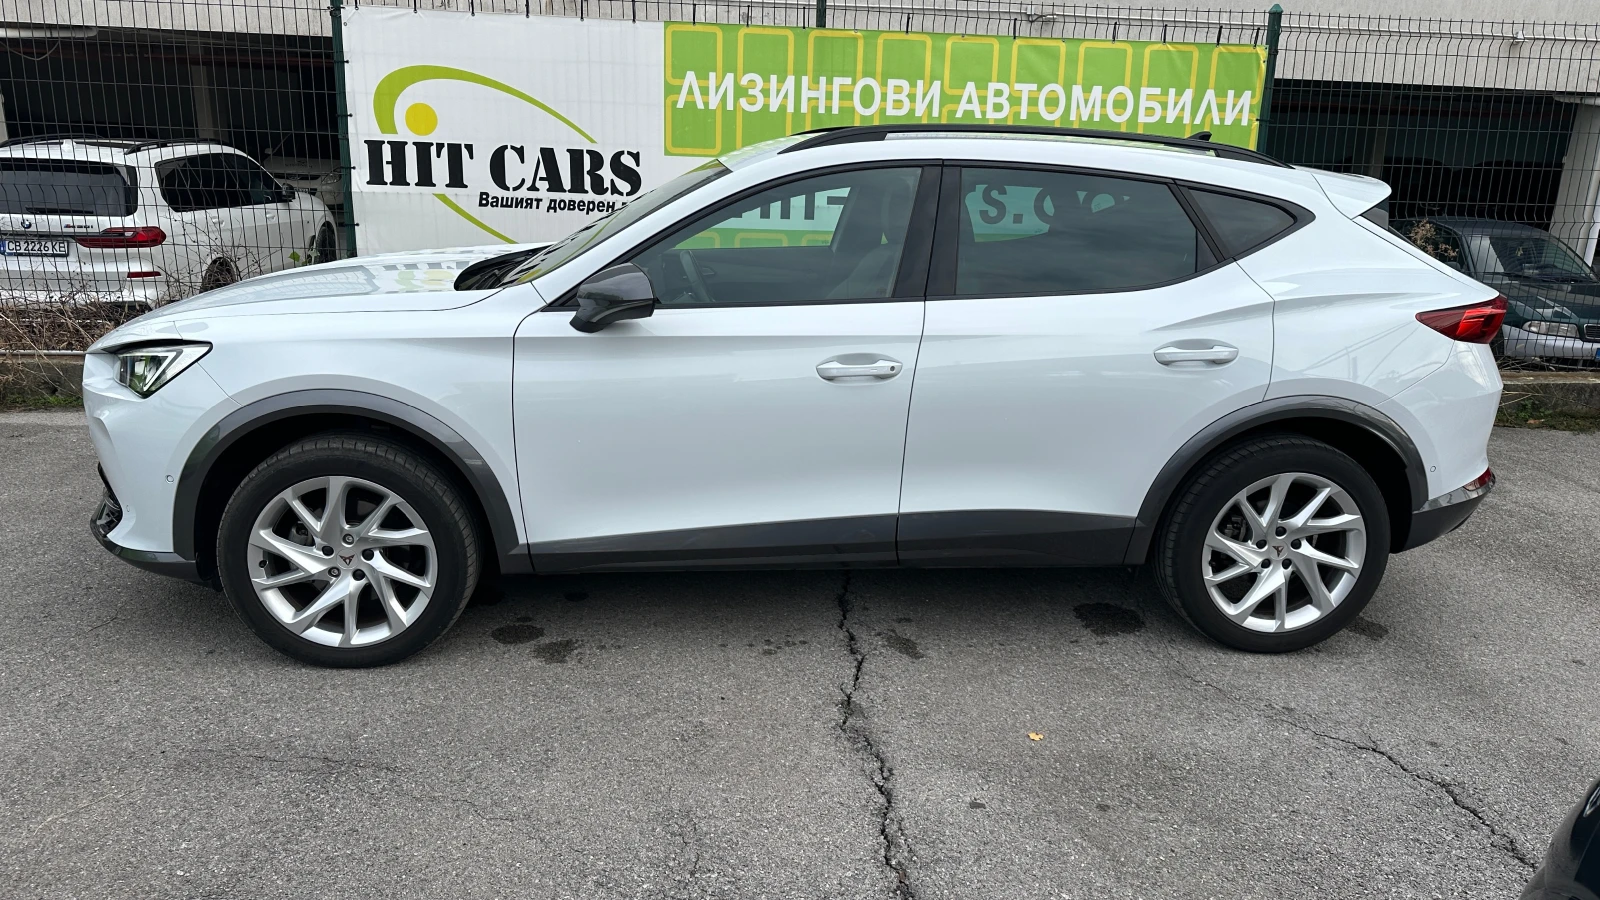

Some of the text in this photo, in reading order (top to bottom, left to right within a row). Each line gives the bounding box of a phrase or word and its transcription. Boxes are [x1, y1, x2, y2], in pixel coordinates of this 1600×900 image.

[677, 70, 1252, 126] ЛИЗИНГОВИ АВТОМОБИЛИ
[364, 139, 643, 197] HIT CARS
[478, 191, 616, 215] Вашият доверен
[23, 241, 50, 252] 2226
